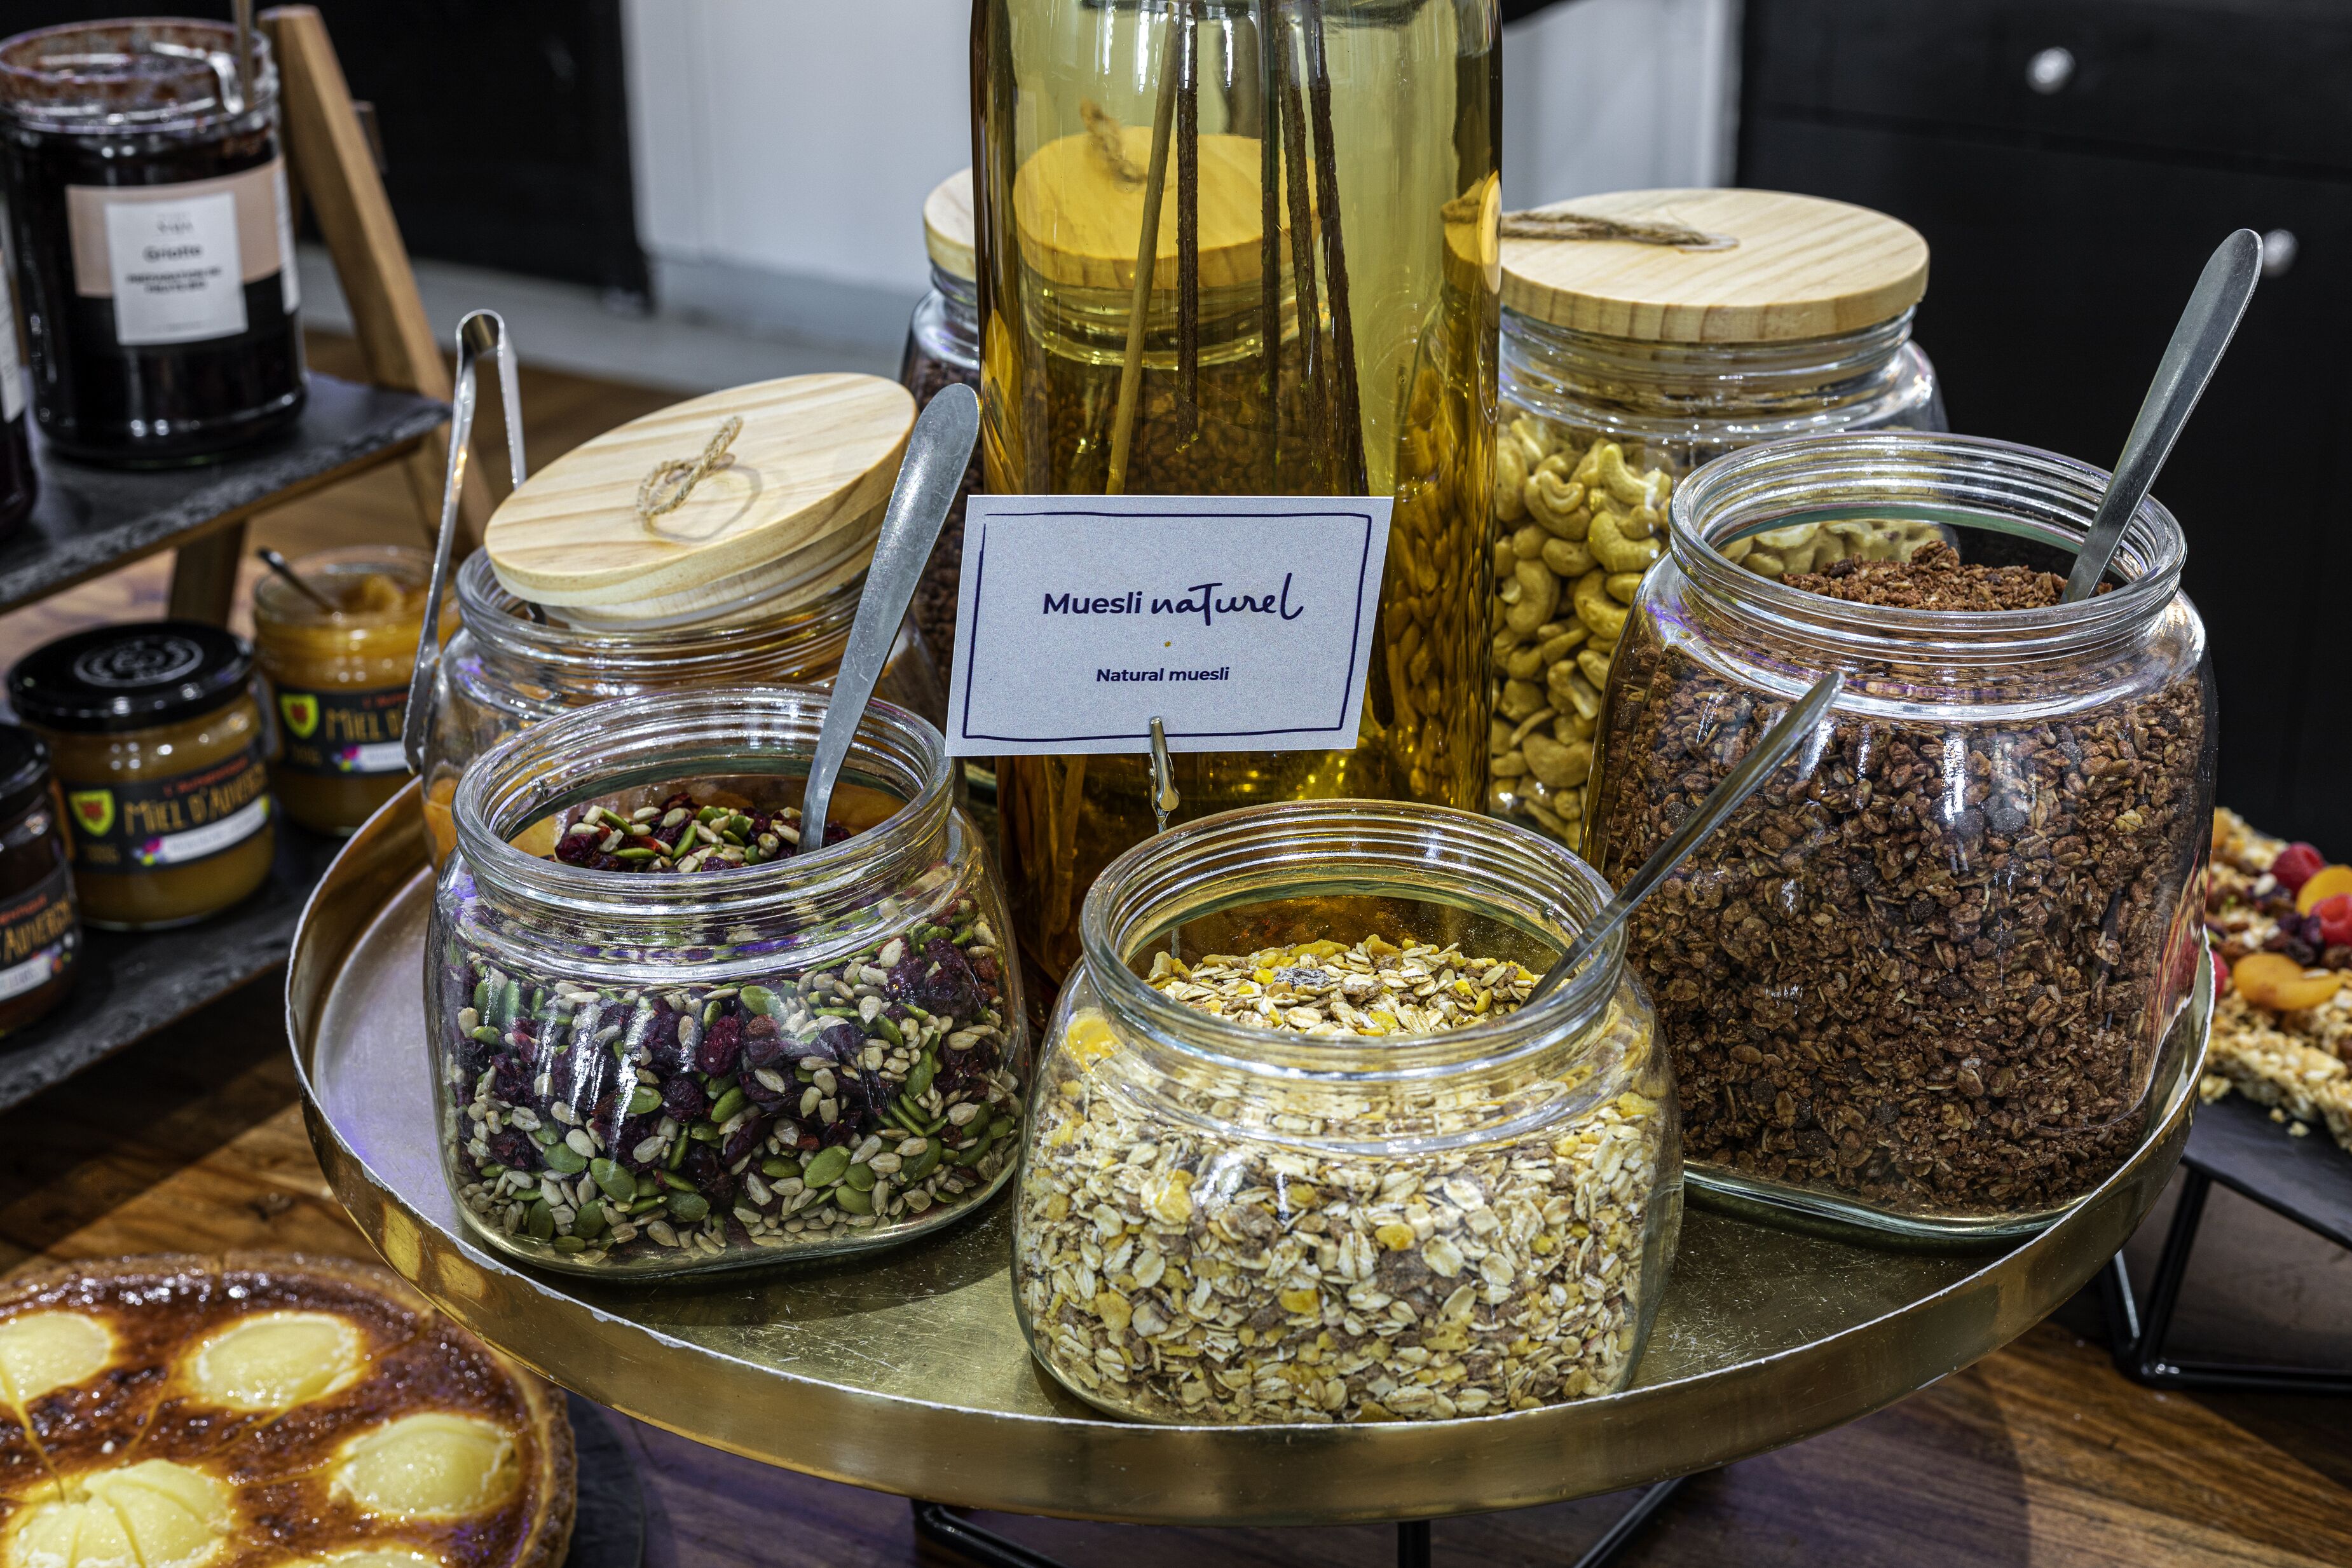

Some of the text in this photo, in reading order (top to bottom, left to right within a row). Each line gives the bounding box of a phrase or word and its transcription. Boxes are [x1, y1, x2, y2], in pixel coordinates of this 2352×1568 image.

[1044, 591, 1142, 613] Muesli
[1097, 667, 1229, 681] Natural muesli
